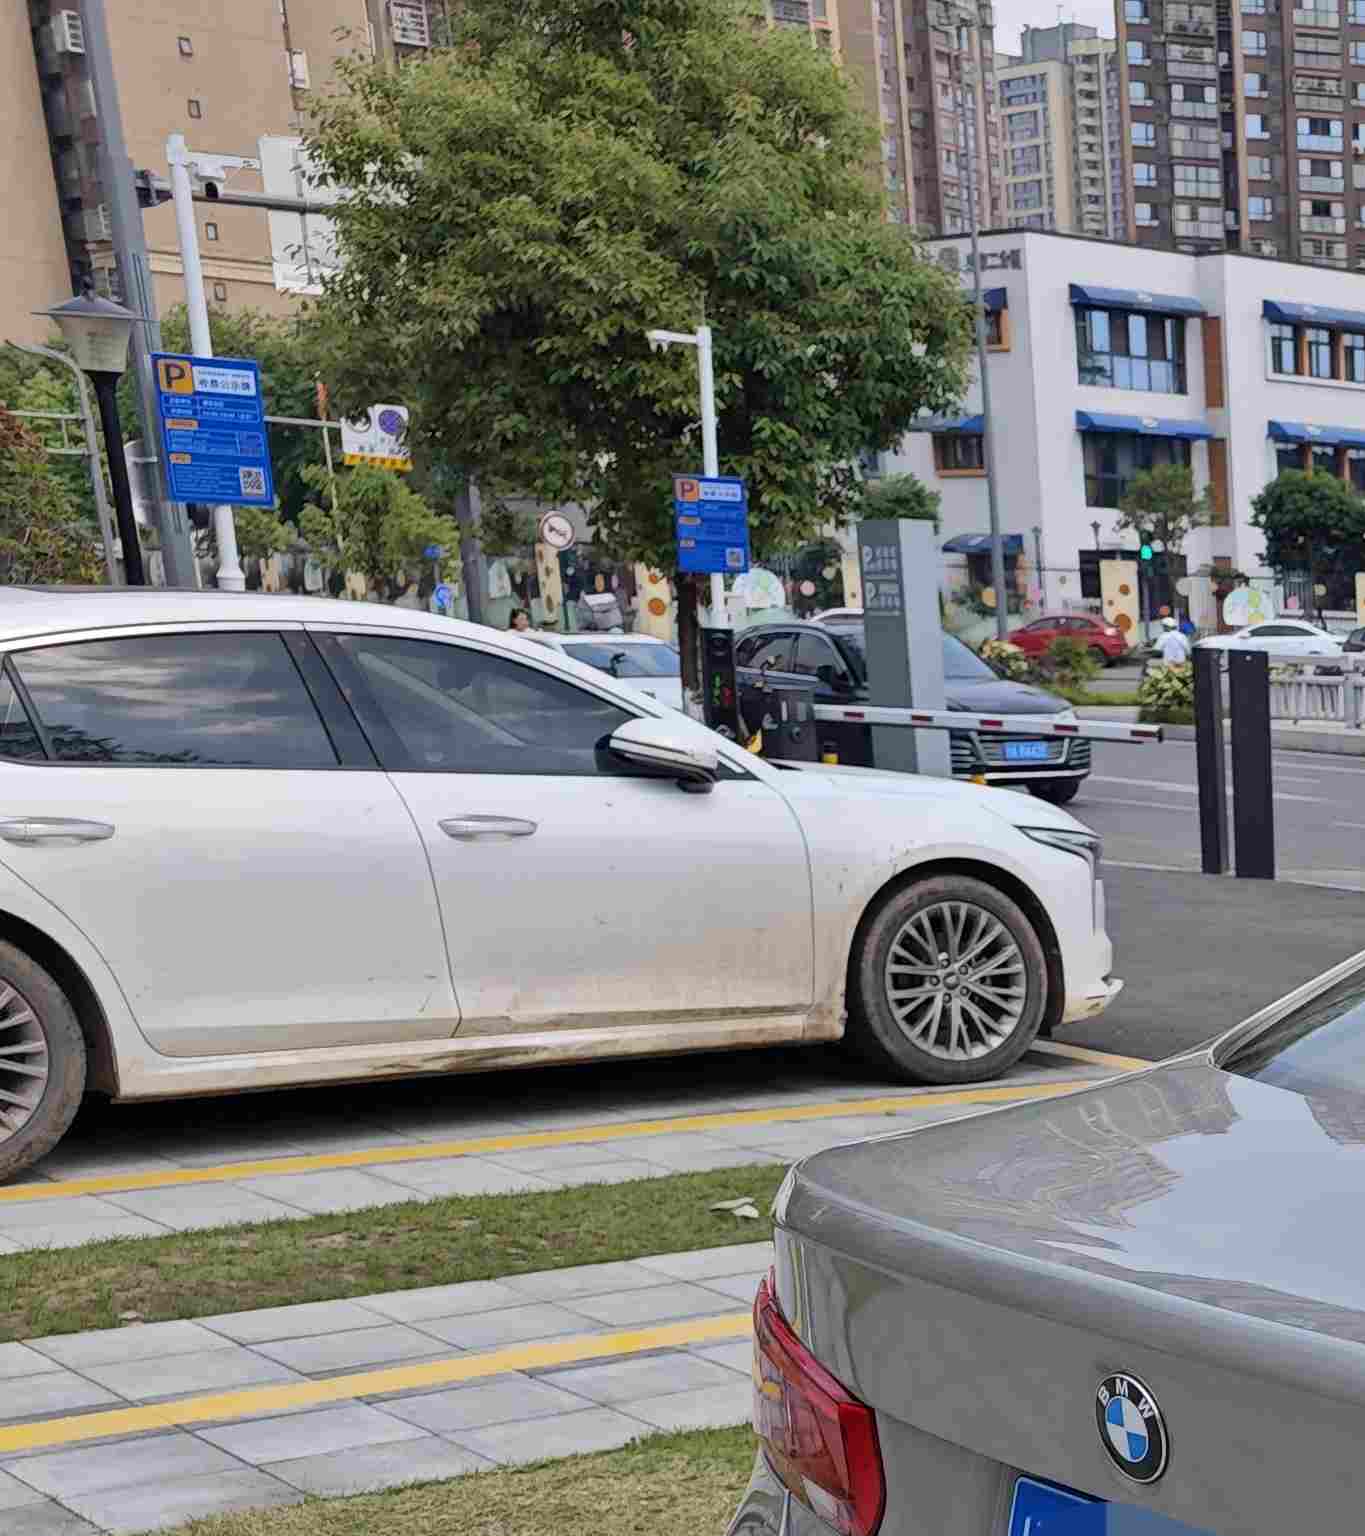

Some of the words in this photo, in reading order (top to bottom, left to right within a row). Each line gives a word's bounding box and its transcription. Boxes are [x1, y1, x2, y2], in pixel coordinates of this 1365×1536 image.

[165, 364, 187, 389] P
[680, 481, 694, 499] P
[1097, 1378, 1154, 1418] BMW
